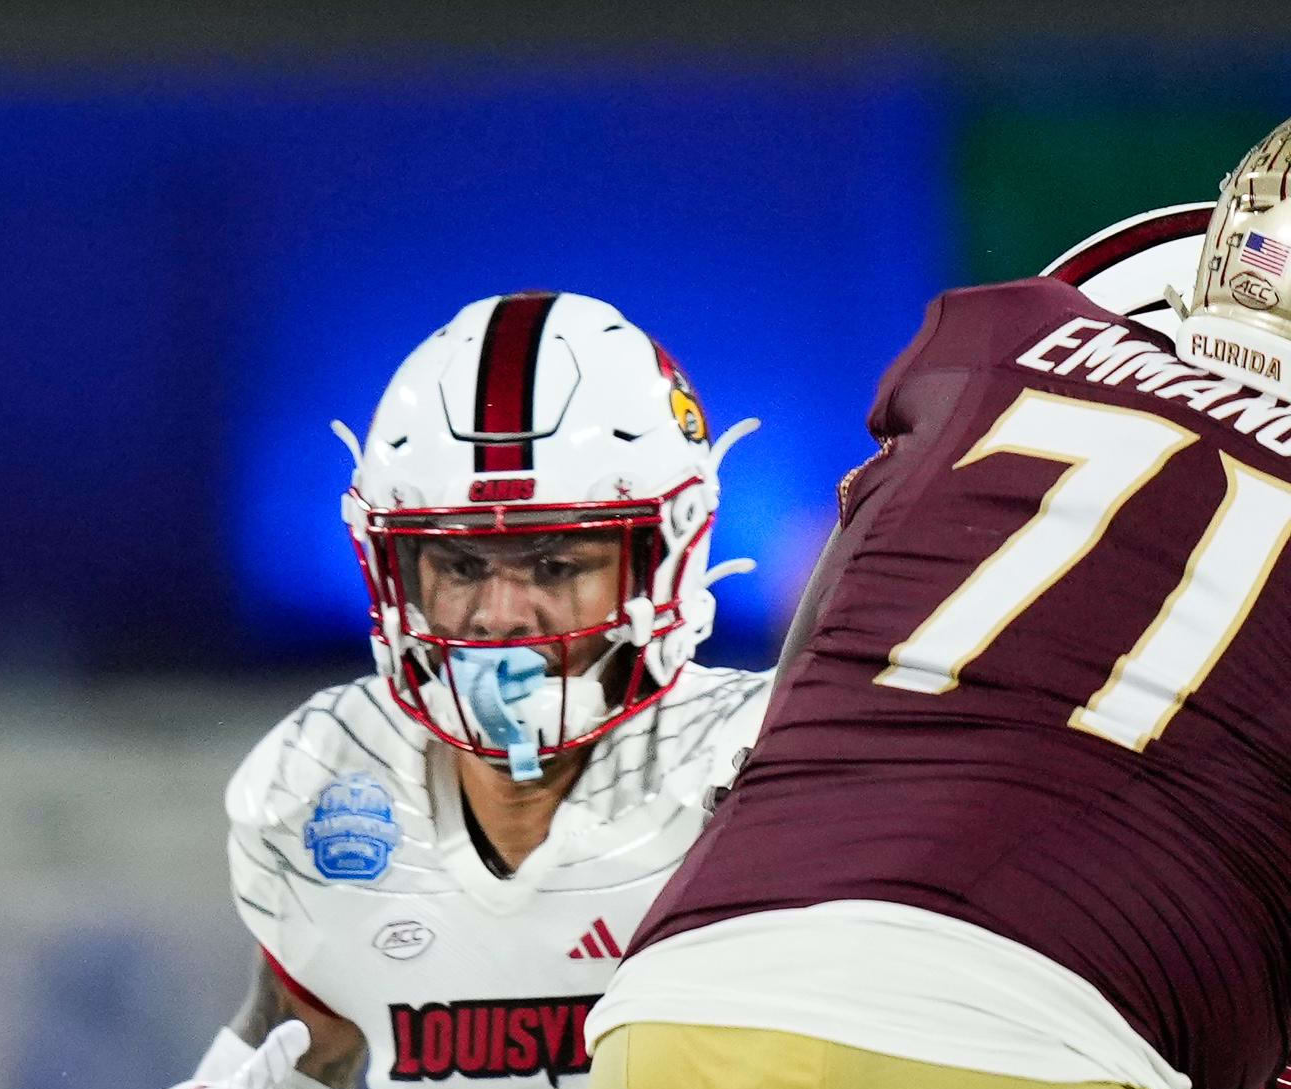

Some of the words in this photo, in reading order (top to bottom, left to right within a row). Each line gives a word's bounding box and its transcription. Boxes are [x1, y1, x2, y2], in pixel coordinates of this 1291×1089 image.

[1234, 279, 1273, 304] ACC
[1191, 333, 1281, 382] FLORIDA
[871, 388, 1291, 753] 71
[383, 927, 425, 946] ACC
